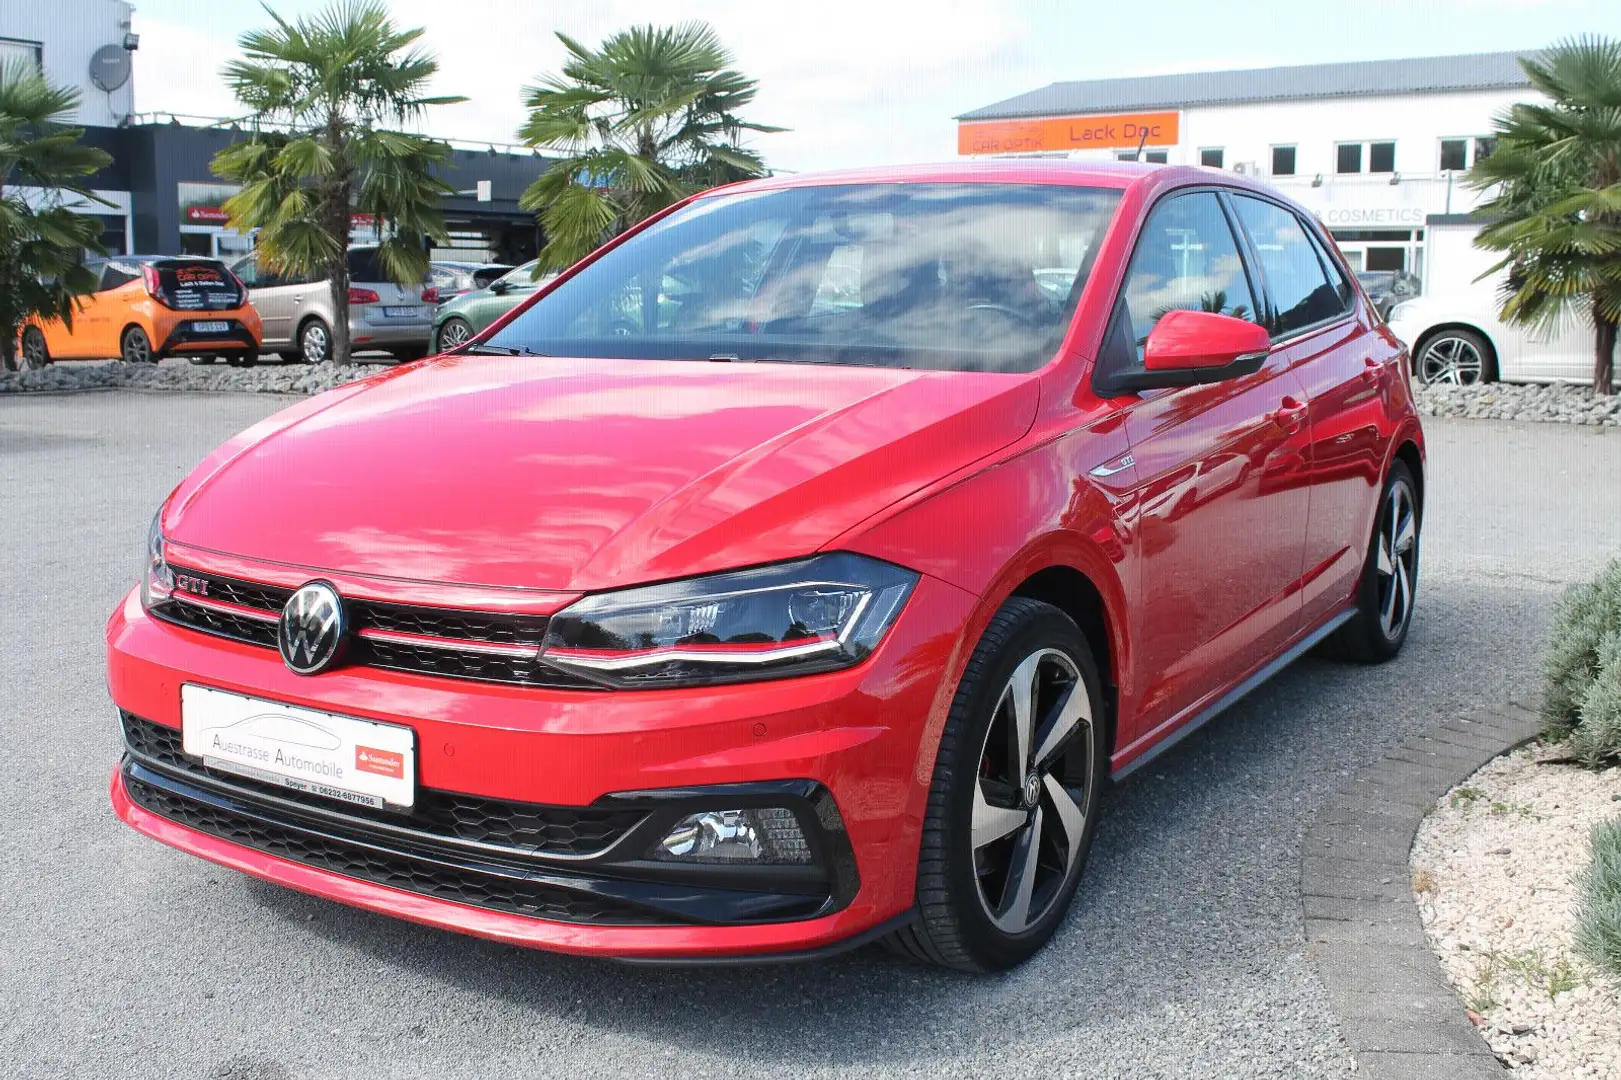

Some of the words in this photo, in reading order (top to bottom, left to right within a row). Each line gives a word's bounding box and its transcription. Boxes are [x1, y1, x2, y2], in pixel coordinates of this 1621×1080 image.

[1069, 124, 1115, 142] Lack
[1124, 123, 1161, 139] Doc
[973, 138, 999, 152] CAR
[1004, 136, 1044, 150] OPTIK
[1328, 208, 1424, 223] COSMETICS
[175, 574, 208, 596] GTI
[213, 733, 270, 762] Auestrasse
[274, 748, 343, 779] Automobile
[368, 753, 401, 768] Santander
[284, 778, 308, 790] Speyer
[319, 786, 375, 806] 06232-6877956
